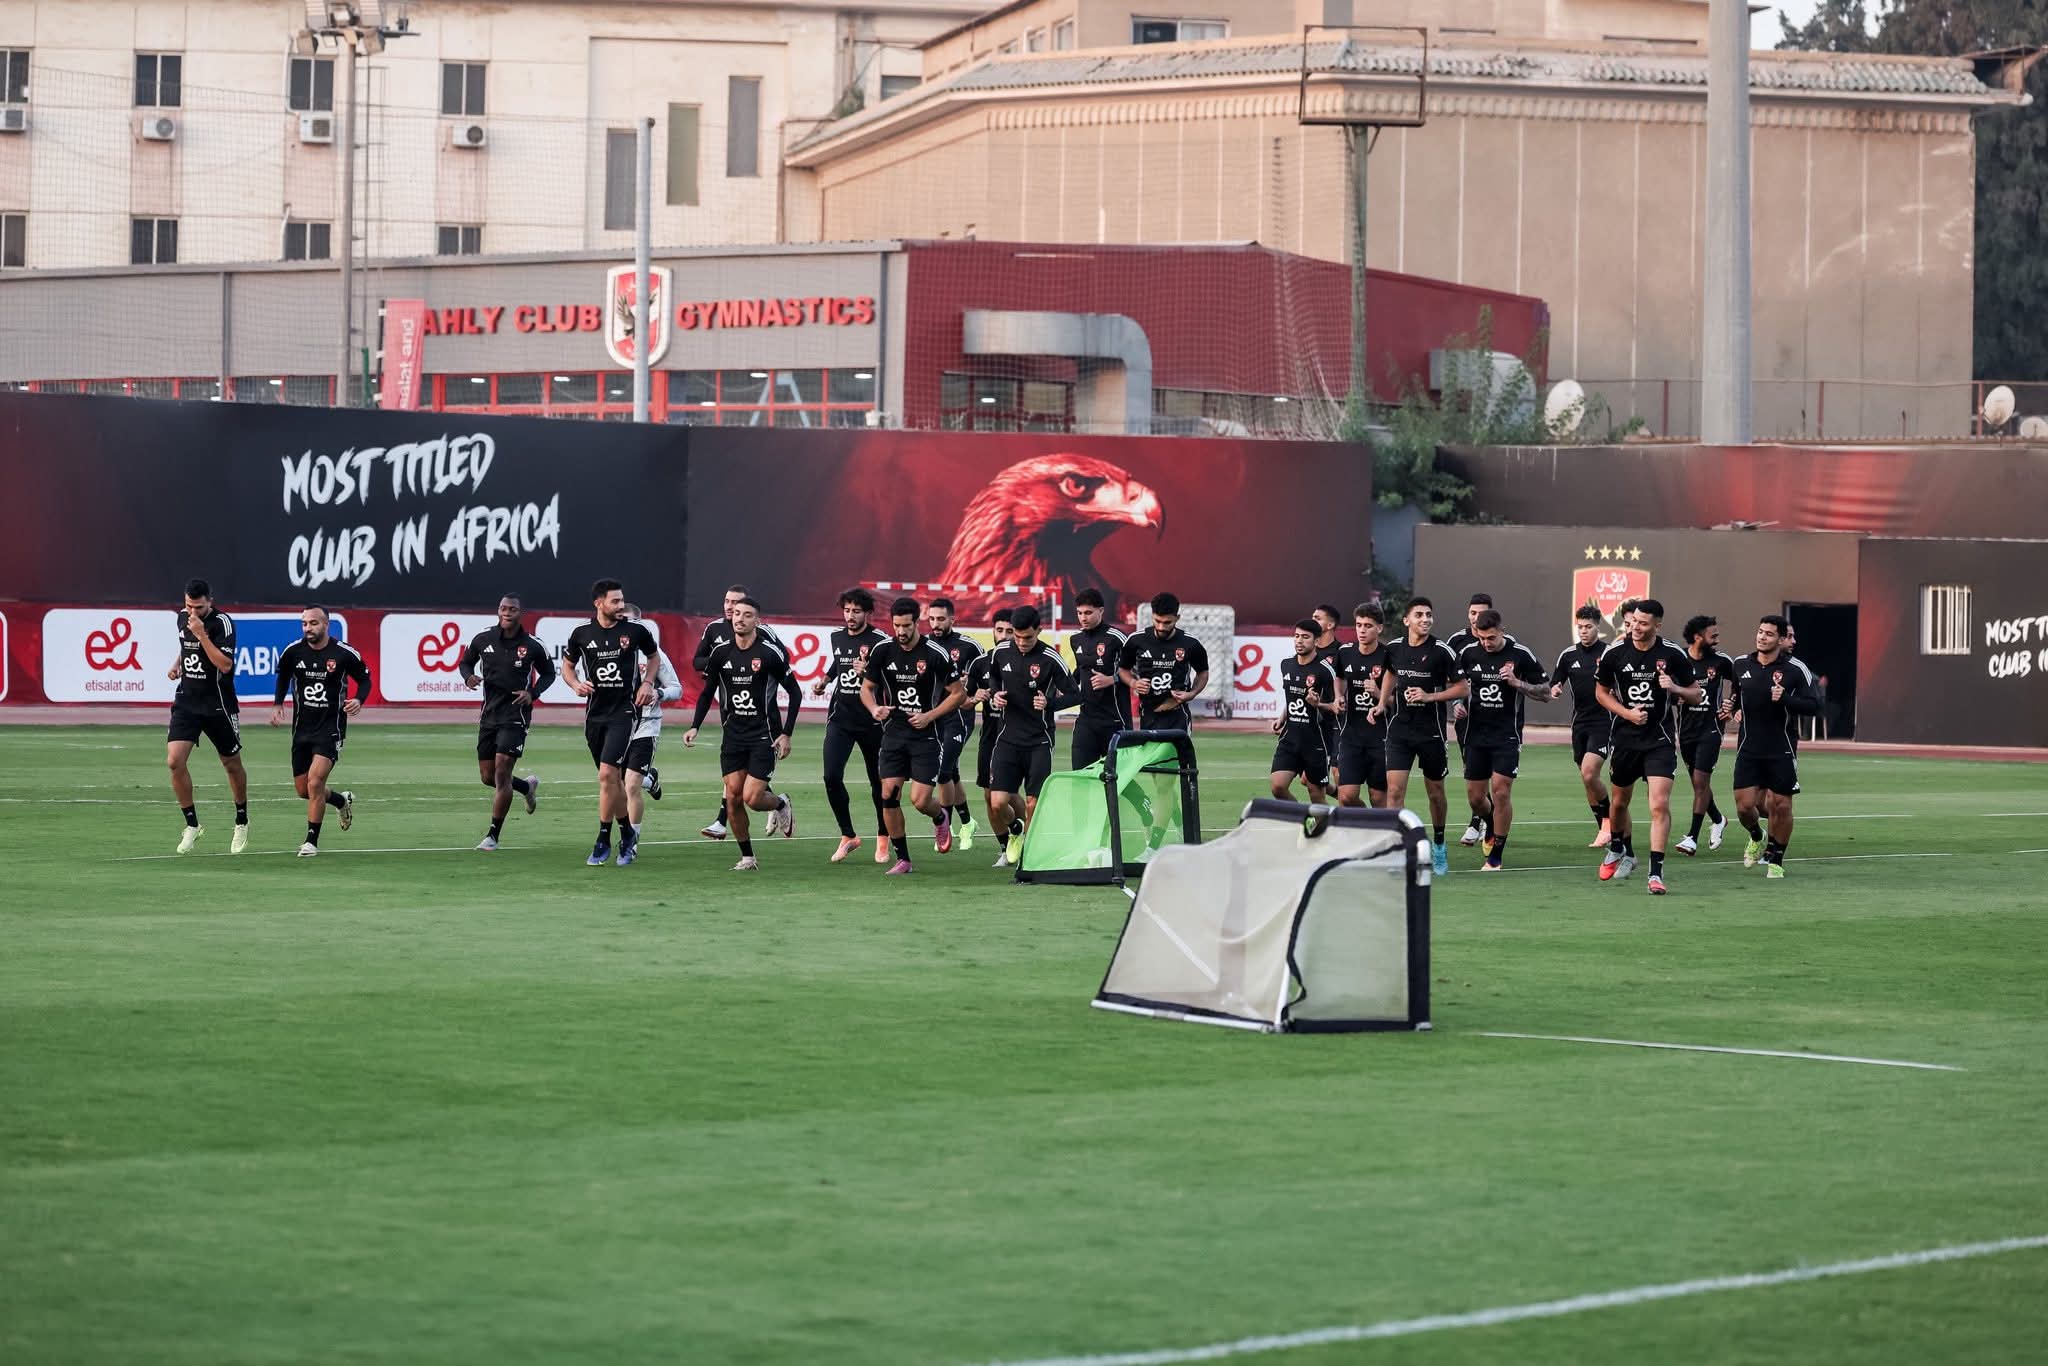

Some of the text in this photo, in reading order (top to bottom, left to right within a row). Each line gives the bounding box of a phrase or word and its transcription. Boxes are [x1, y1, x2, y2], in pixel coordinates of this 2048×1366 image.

[424, 295, 875, 335] AHLY CLUB GYMNASTICS
[281, 432, 495, 515] MOST TITLED
[288, 492, 560, 589] CLUB IN AFRICA
[1985, 617, 2036, 647] MOST
[1988, 650, 2032, 678] CLUB
[85, 680, 145, 692] etisalat and
[416, 681, 452, 692] etisalat
[1253, 700, 1277, 711] and
